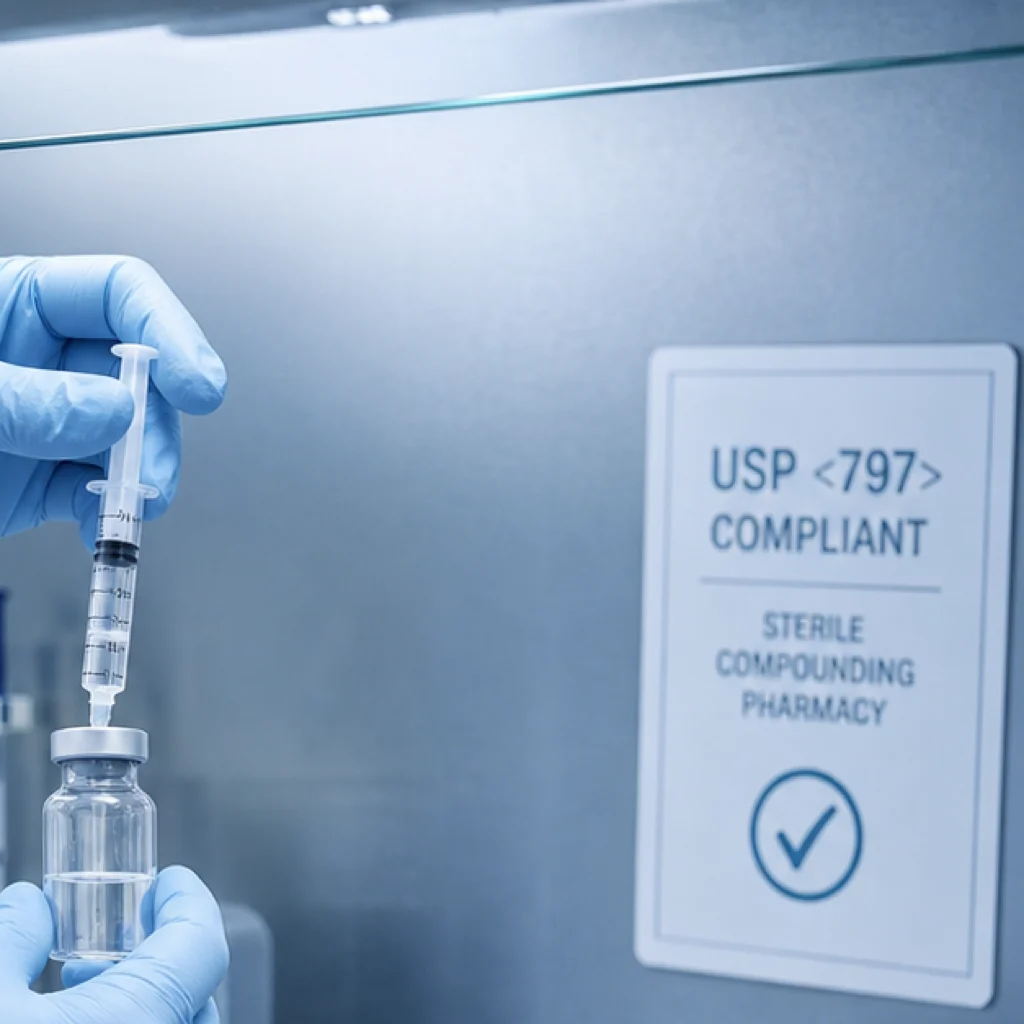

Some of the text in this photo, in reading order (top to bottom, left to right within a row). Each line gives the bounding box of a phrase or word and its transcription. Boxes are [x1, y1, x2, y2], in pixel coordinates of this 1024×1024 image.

[712, 447, 942, 494] USP <797>
[711, 513, 928, 556] COMPLIANT
[763, 611, 864, 643] STERILE
[716, 648, 915, 687] COMPOUNDING
[742, 691, 887, 725] PHARMACY
